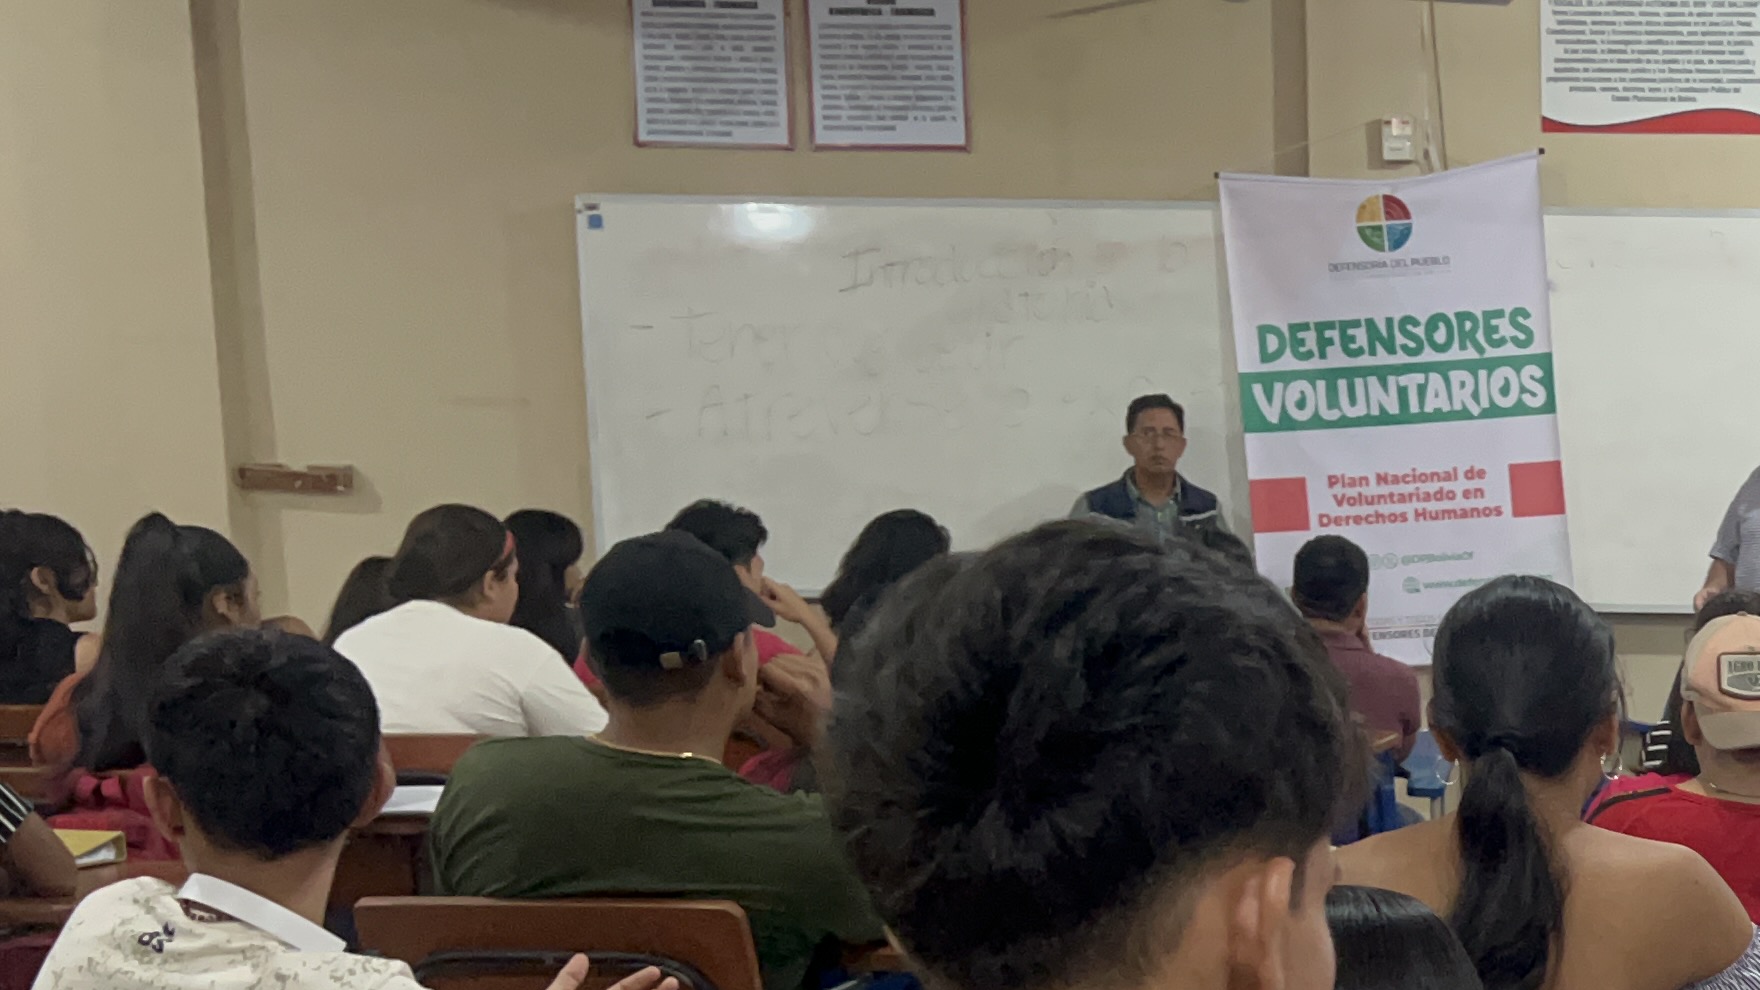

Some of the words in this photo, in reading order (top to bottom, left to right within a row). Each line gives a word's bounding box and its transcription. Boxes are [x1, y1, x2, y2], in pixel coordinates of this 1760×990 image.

[1256, 306, 1535, 364] DEFENSORES
[1251, 364, 1548, 425] VOLUNTARIOS
[1327, 474, 1370, 489] Plan
[1375, 466, 1459, 487] Nacional
[1464, 465, 1487, 480] de
[1332, 487, 1457, 507] Voluntariado
[1462, 486, 1485, 501] en
[1318, 510, 1408, 528] Derechos
[1414, 504, 1504, 522] Humanos
